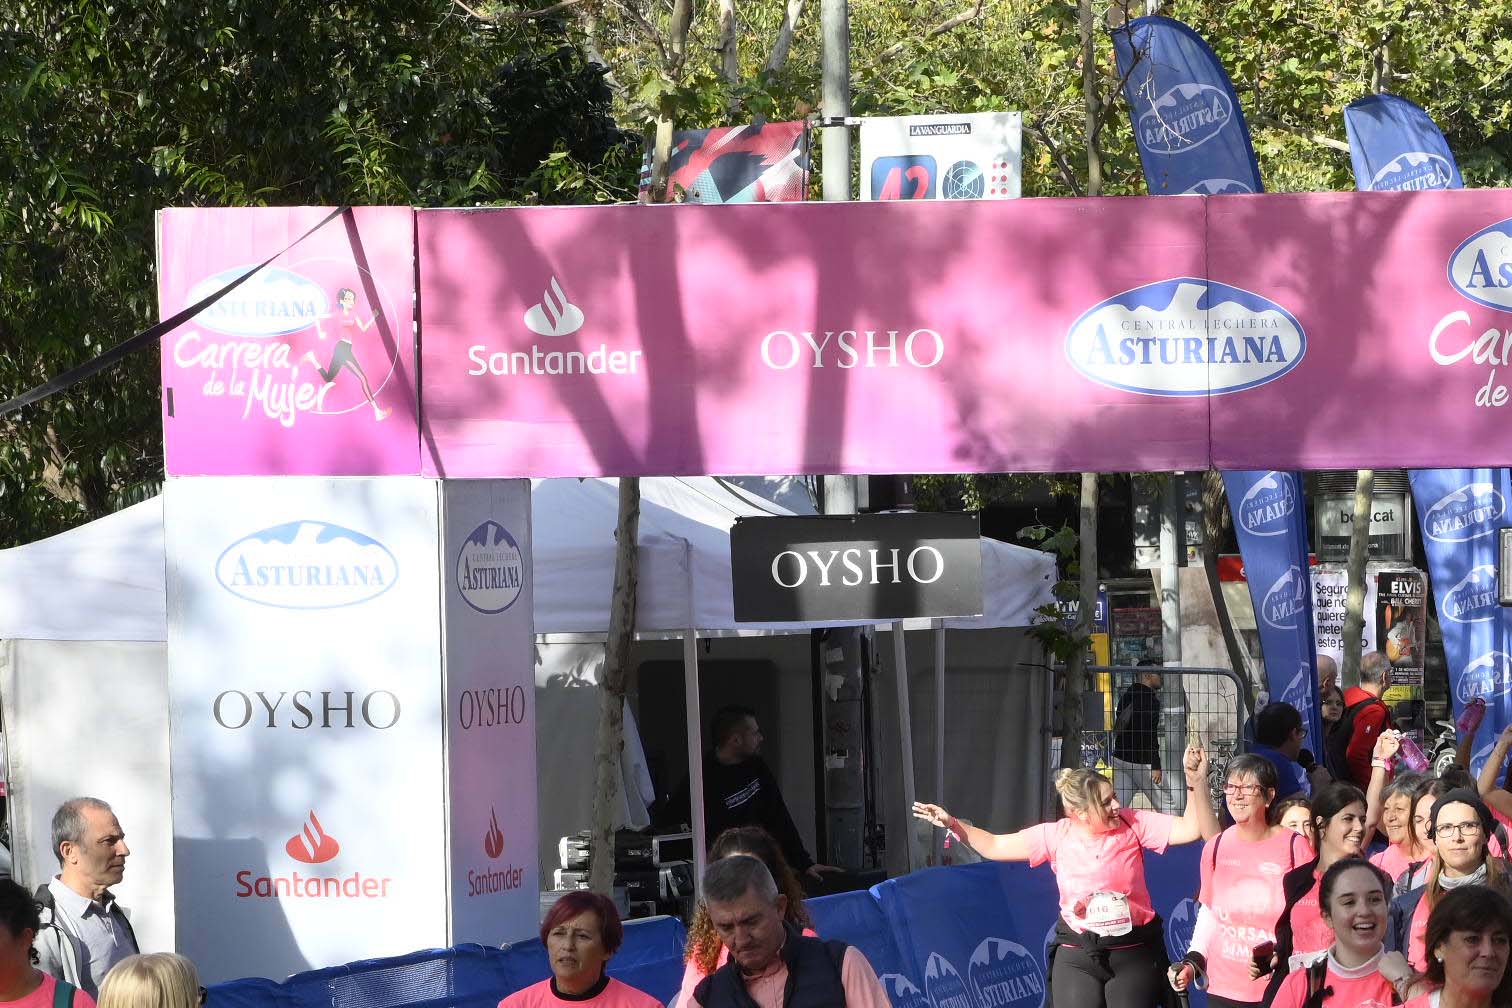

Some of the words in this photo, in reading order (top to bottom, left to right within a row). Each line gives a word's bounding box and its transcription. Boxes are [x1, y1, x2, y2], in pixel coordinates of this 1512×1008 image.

[1121, 319, 1196, 331] CENTRAL
[1203, 317, 1279, 329] LECHERA
[174, 331, 291, 370] Carrera
[468, 344, 642, 377] Santander
[761, 329, 944, 369] OYSHO
[1087, 323, 1287, 366] ASTURIANA
[203, 373, 225, 397] de
[229, 368, 245, 397] la
[243, 365, 336, 427] Mujer
[1475, 368, 1509, 407] de
[230, 553, 386, 587] ASTURIANA
[462, 554, 520, 592] ASTURIANA
[771, 545, 945, 588] OYSHO
[1391, 581, 1421, 594] ELVIS
[213, 689, 401, 730] OYSHO
[459, 685, 526, 730] OYSHO
[236, 870, 393, 899] Santander
[468, 863, 524, 898] Santander
